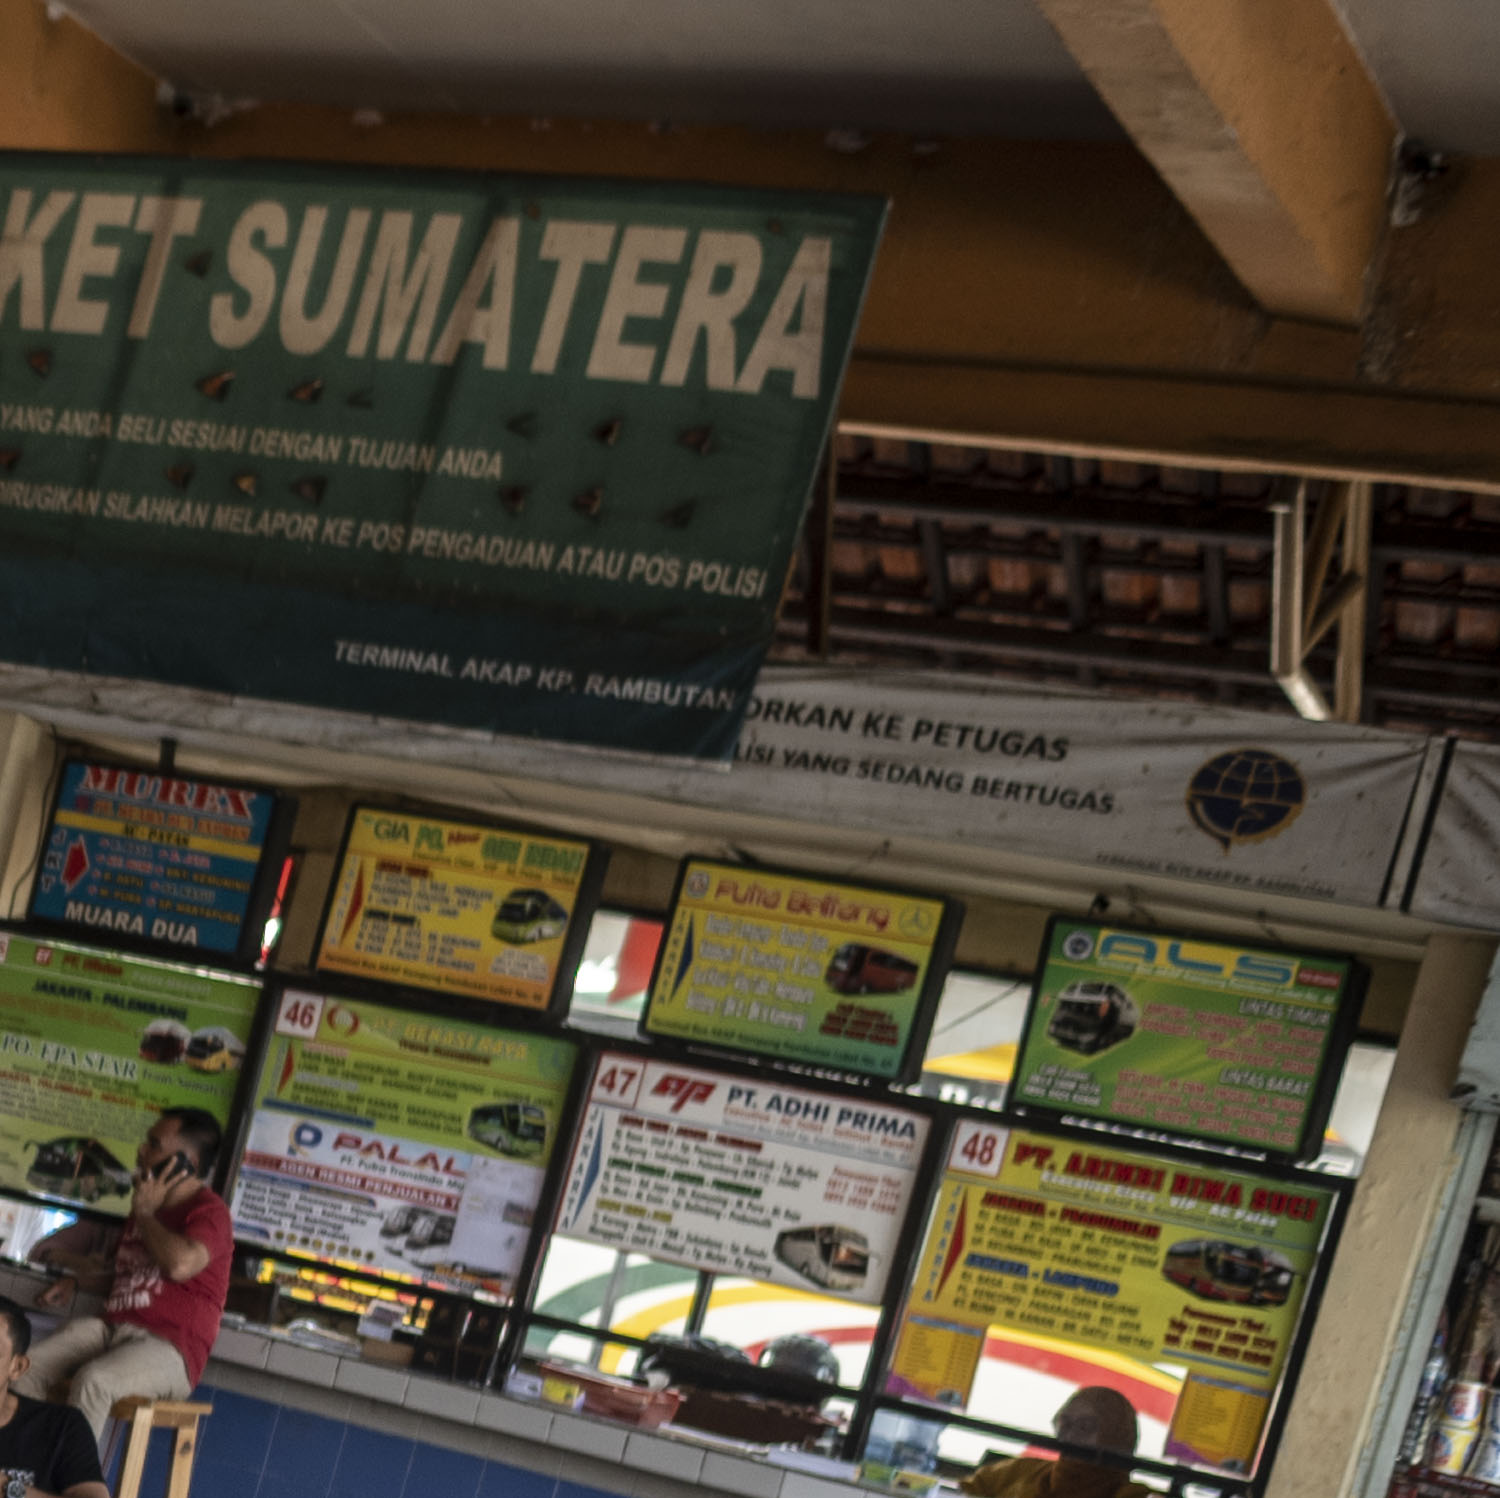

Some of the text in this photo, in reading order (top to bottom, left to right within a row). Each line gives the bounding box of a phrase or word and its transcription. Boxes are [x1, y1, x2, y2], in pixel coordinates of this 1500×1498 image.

[207, 200, 833, 399] SUMATERA
[51, 409, 114, 442] ANDA
[116, 416, 167, 447] BELI
[166, 420, 247, 456] SESUAI
[247, 428, 342, 466] DENGAN
[344, 437, 437, 474] TUJUAN
[436, 446, 505, 482] ANDA
[101, 491, 212, 530] SILAHKAN
[211, 505, 320, 545] MELAPOR
[321, 515, 355, 547] KE
[353, 522, 407, 556] POS
[407, 527, 556, 573] PENGADUAN
[555, 544, 629, 581] ATAU
[628, 552, 684, 590] POS
[682, 562, 770, 602] POLISI
[331, 637, 737, 715] TERMINAL AKAP KP. RAMBUTAN
[860, 710, 903, 742] KE
[910, 714, 1070, 765] PETUGAS
[77, 766, 255, 823] MUREX
[779, 747, 852, 778] YANG
[856, 758, 967, 795] SEDANG
[969, 774, 1116, 816] BERTUGAS
[63, 899, 200, 946] MUARA DUA
[1099, 934, 1298, 987] ALS
[32, 979, 188, 1021] JAKARTA PALEMBANG
[282, 999, 317, 1030] 46
[81, 1052, 138, 1079] STAR
[596, 1064, 918, 1143] 47 PT. ADHI PRIMA
[278, 1159, 316, 1178] AGEN
[316, 1167, 363, 1188] RESMI
[363, 1177, 444, 1207] PENJUALAN
[959, 1130, 1319, 1224] 48 PT. ARIMBI BIMA SUCI
